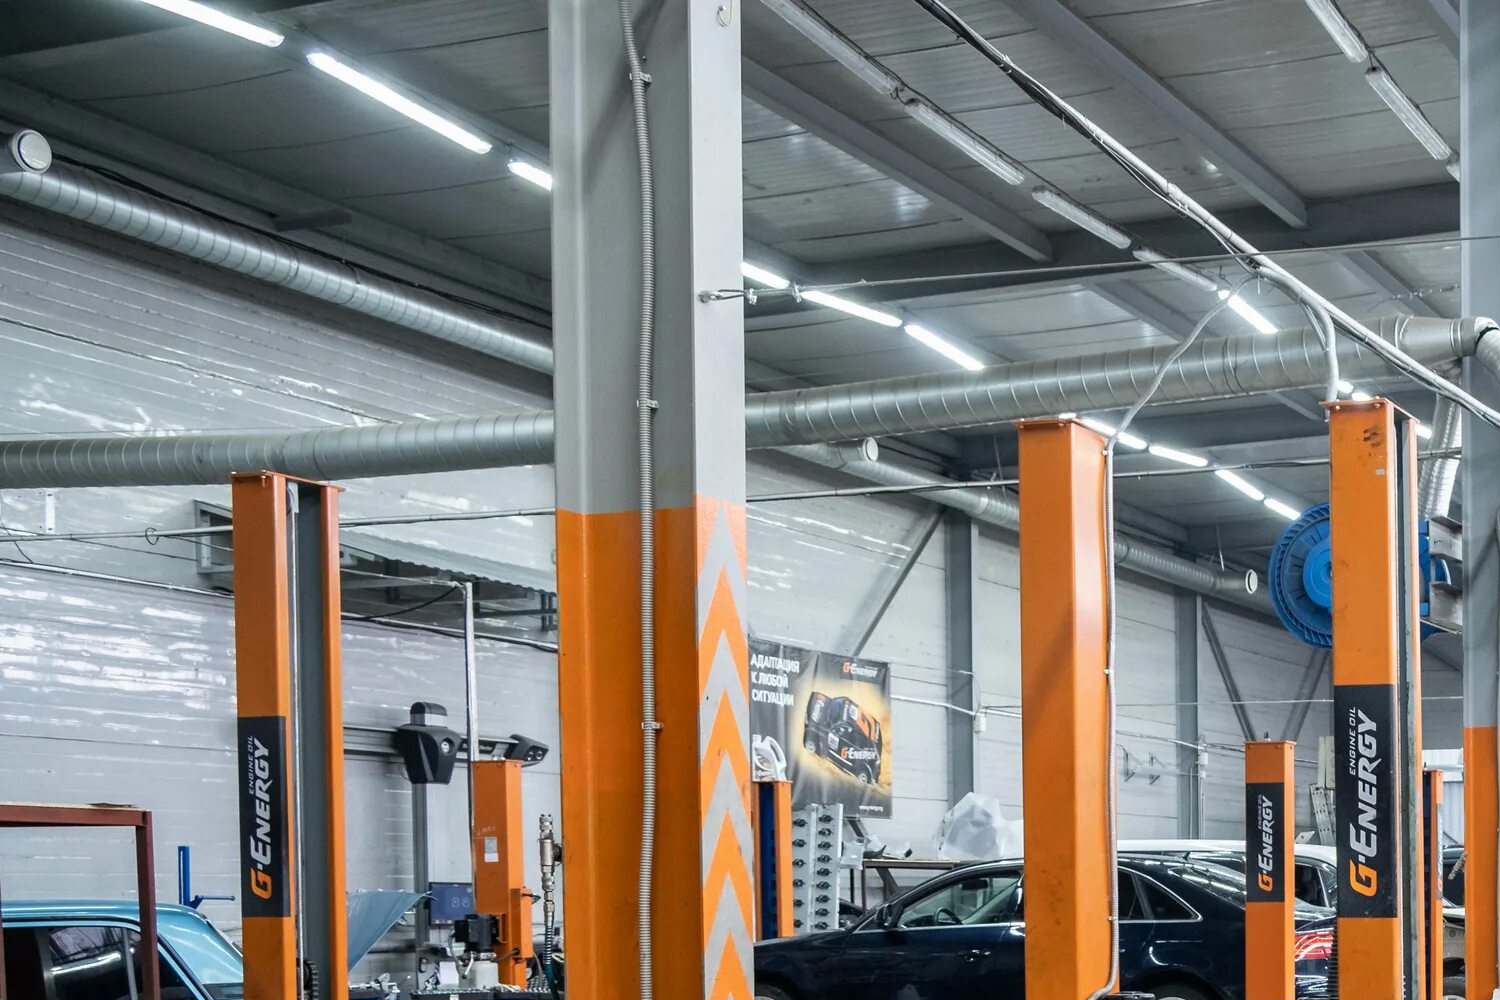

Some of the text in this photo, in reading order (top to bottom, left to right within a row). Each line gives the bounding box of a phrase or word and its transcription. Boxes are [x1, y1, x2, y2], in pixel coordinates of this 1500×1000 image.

[750, 653, 800, 674] АДАПТАЦИЯ
[751, 671, 789, 688] К ЛЮБОЙ
[751, 689, 794, 707] СИТУАЦИИ
